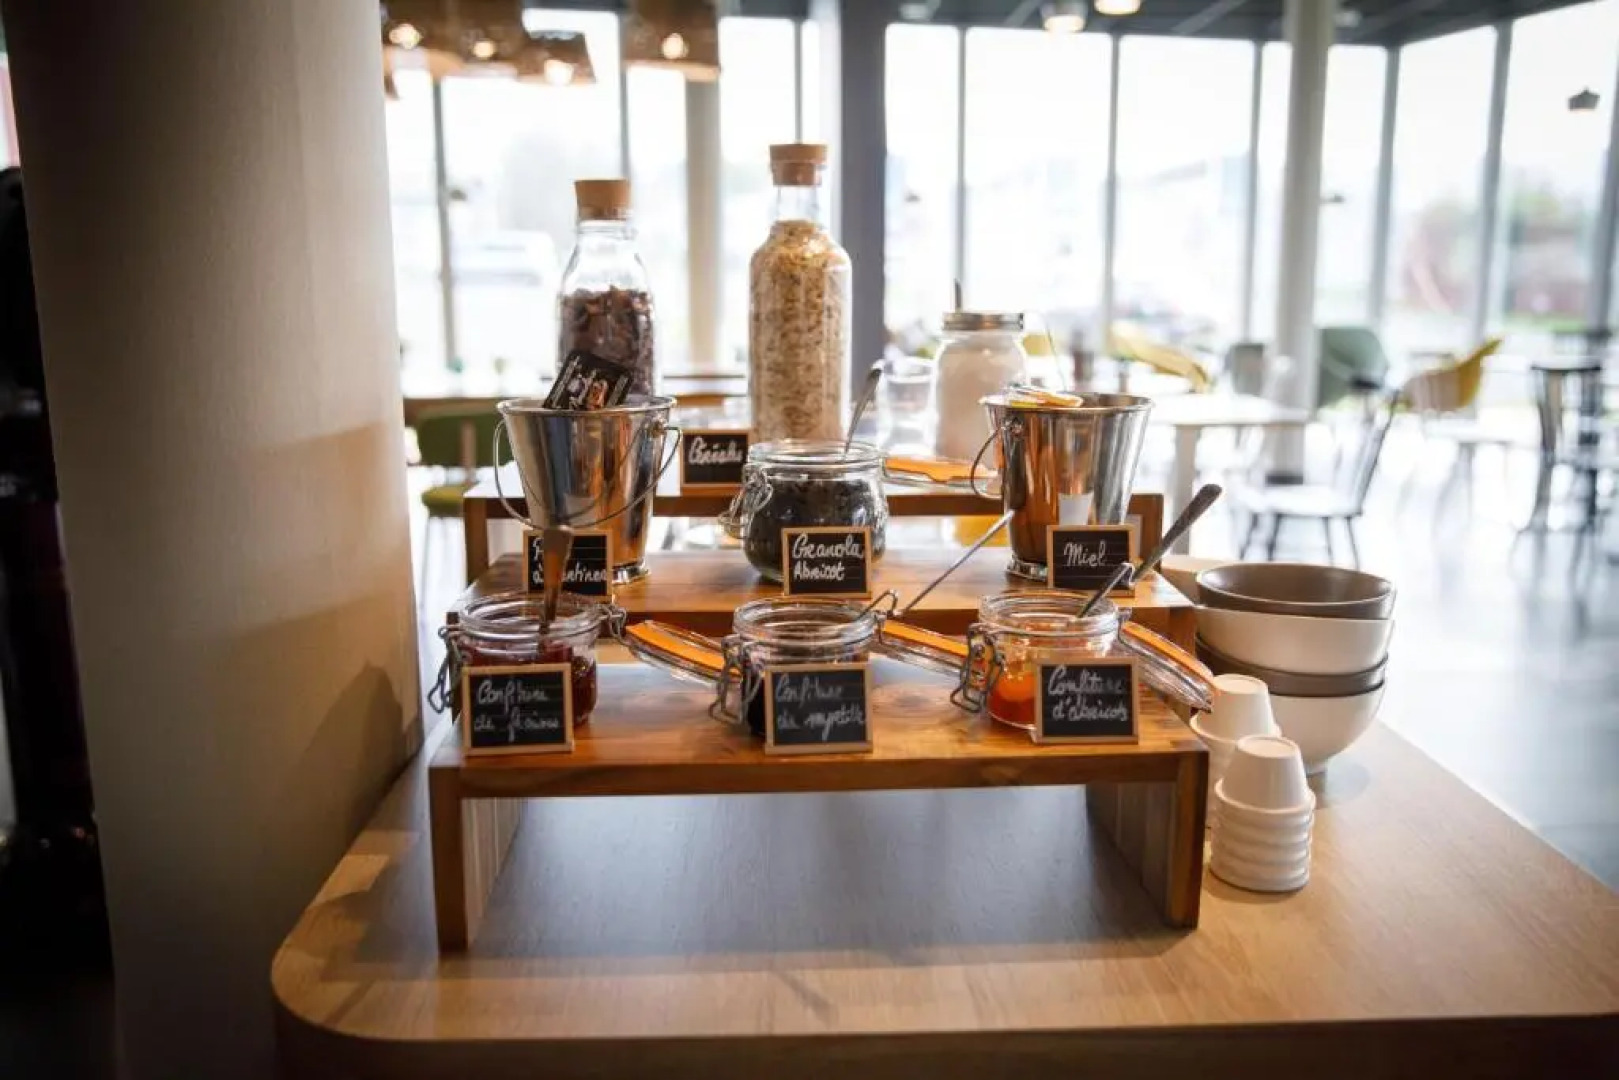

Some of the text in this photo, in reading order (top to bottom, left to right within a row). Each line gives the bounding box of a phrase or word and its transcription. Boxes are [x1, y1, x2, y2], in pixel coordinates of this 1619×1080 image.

[792, 531, 864, 558] Granola
[1064, 540, 1107, 567] Miel
[793, 560, 845, 581] Abricot
